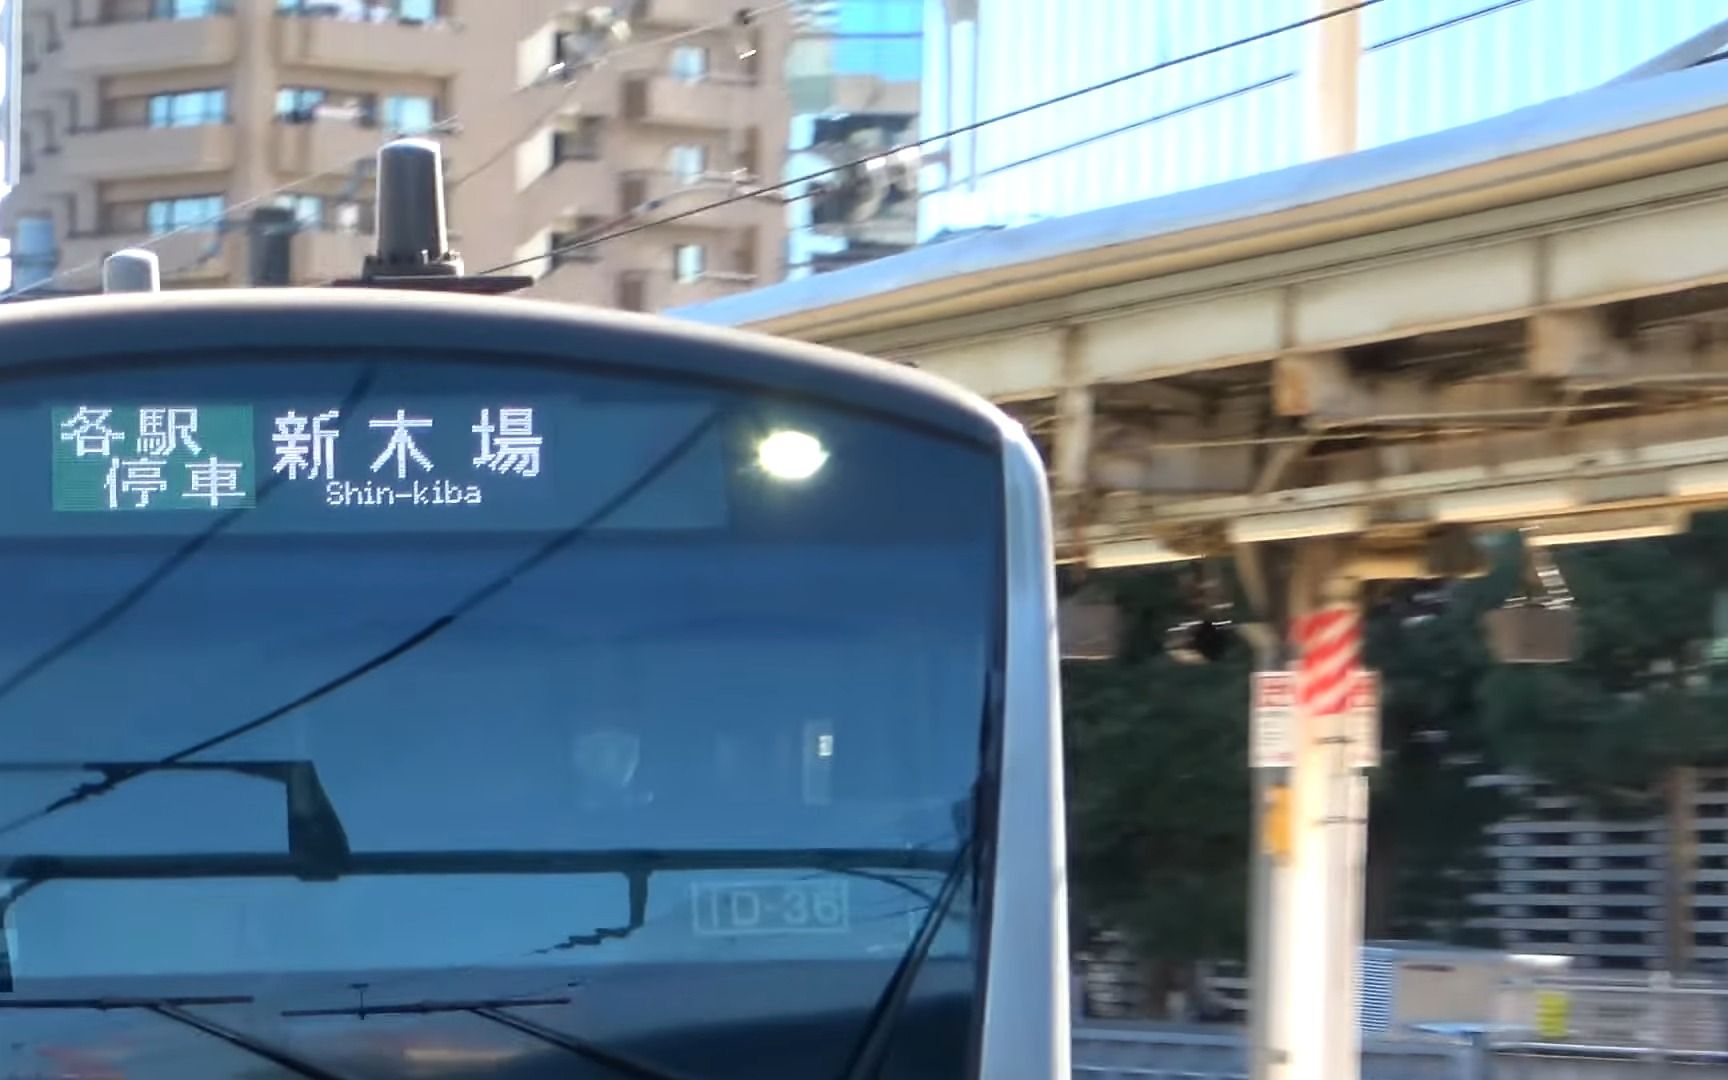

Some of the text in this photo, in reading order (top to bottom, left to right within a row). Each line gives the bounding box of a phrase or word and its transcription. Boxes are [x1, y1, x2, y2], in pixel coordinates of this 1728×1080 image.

[61, 406, 202, 457] 各駅
[272, 408, 542, 480] 新木場
[103, 457, 246, 509] 停車
[326, 481, 482, 505] Shin-kiba
